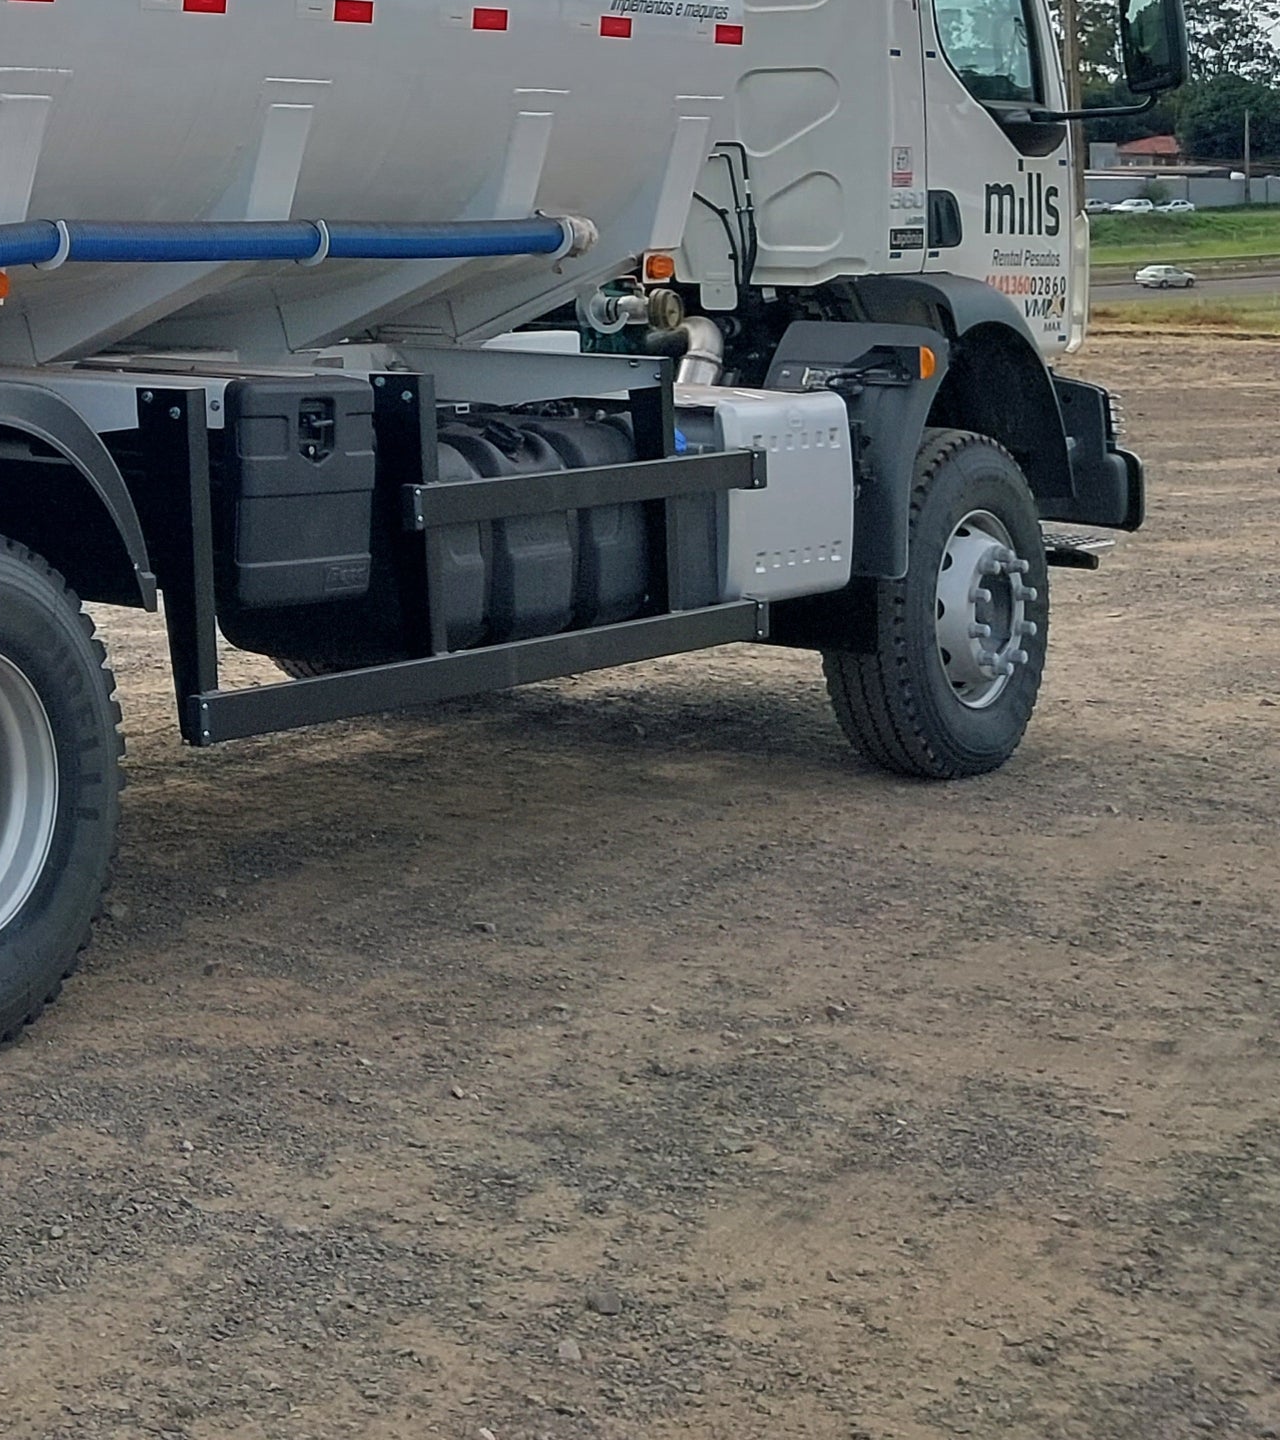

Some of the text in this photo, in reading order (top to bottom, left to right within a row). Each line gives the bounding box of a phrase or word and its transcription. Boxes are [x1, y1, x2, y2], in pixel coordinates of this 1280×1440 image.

[675, 2, 682, 14] e
[985, 159, 1060, 236] mills
[992, 249, 1060, 267] Rental Pesados
